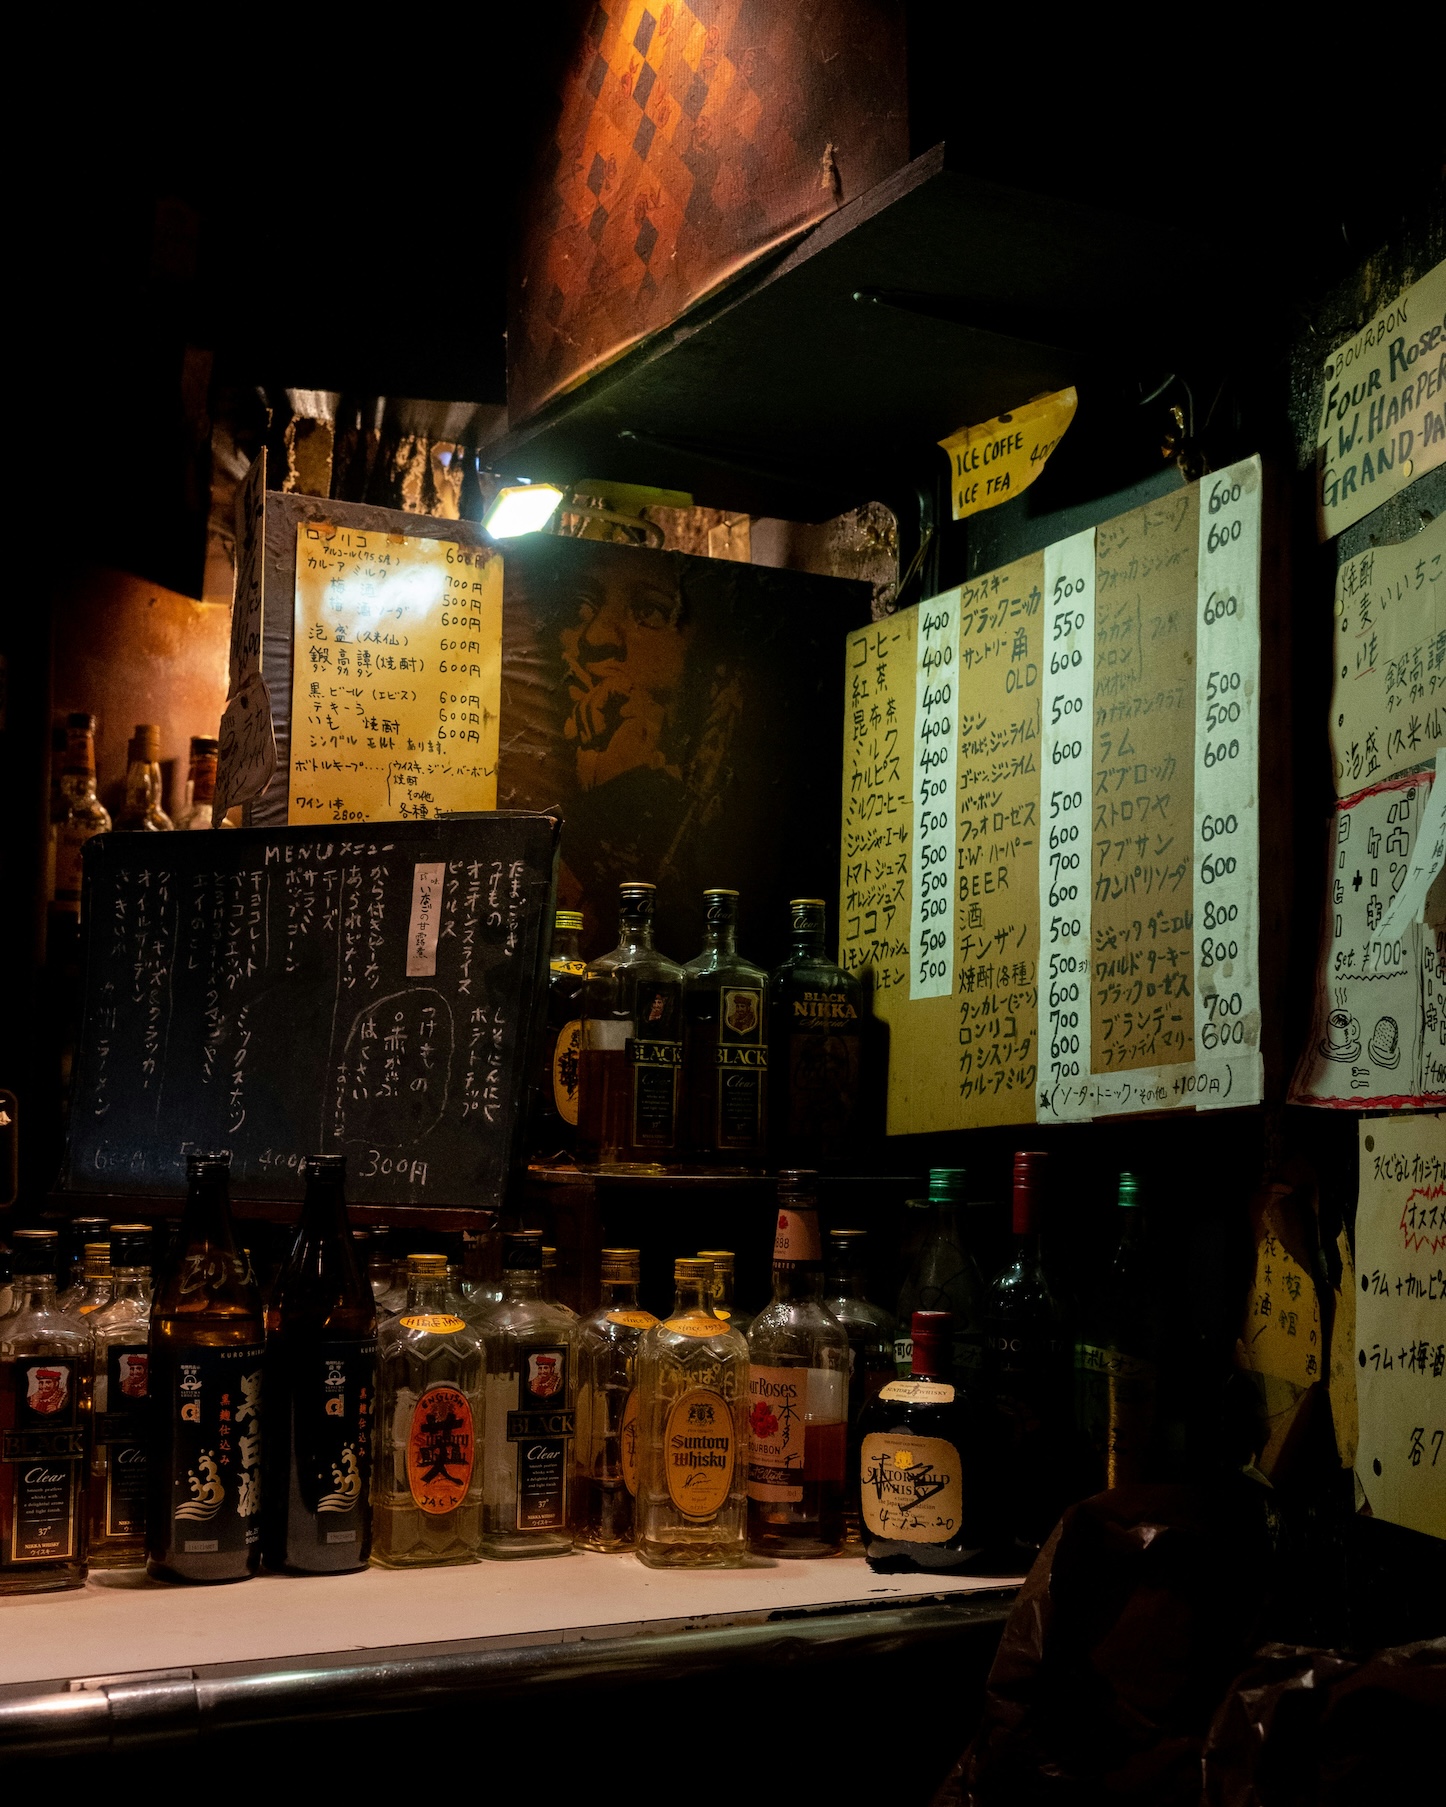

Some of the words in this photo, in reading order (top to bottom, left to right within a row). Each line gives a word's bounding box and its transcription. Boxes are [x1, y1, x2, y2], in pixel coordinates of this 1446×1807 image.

[1334, 298, 1408, 378] BOURBON
[1324, 368, 1382, 429] FOUR
[957, 447, 980, 476] ICE
[983, 432, 1024, 466] COFFE
[1322, 403, 1446, 508] GRAND-DA
[959, 483, 979, 508] ICE
[987, 472, 1010, 495] TEA
[1208, 480, 1241, 514] 600
[306, 529, 367, 548] ロンリコ
[1207, 520, 1241, 554] 600
[445, 575, 482, 595] 700円
[1342, 552, 1376, 599] 焼酎
[443, 594, 481, 614] 500円
[1053, 575, 1085, 606] 500
[1359, 593, 1374, 629] 麦
[1380, 554, 1442, 610] いいちこ
[963, 585, 1041, 636] ブラックニッカ
[1203, 591, 1237, 625] 600
[441, 613, 481, 633] 600円
[922, 612, 949, 640] 400
[1053, 610, 1085, 641] 550
[440, 639, 480, 654] 600円
[852, 632, 901, 668] コーヒー
[1356, 632, 1379, 670] いも
[440, 660, 481, 678] 600円
[922, 646, 952, 677] 400
[1050, 650, 1082, 675] 600
[852, 662, 888, 708] 紅茶
[1005, 663, 1038, 693] OLD
[1206, 671, 1241, 701] 500
[440, 691, 480, 708] 600円
[922, 684, 951, 715] 400
[1051, 694, 1083, 725] 500
[308, 714, 340, 731] いも
[362, 716, 400, 735] 焼酎
[438, 726, 480, 743] 600円
[439, 708, 480, 725] 600円
[853, 697, 898, 741] 昆布茶
[921, 717, 950, 744] 400
[963, 712, 987, 735] ジン
[1206, 702, 1240, 733] 500
[854, 729, 898, 766] ミルク
[1052, 740, 1082, 764] 600
[1100, 728, 1135, 763] ラム
[1204, 739, 1239, 768] 600
[1346, 727, 1381, 780] 泡盛
[852, 757, 900, 792] カルピス
[920, 747, 948, 774] 400
[1096, 753, 1176, 796] ズブロッカ
[393, 775, 418, 786] 焼酎
[920, 778, 947, 805] 500
[408, 789, 435, 803] その他
[961, 791, 1003, 814] バーボン
[1050, 790, 1082, 819] 500
[920, 811, 948, 839] 500
[1050, 825, 1079, 849] 600
[1202, 814, 1238, 842] 600
[265, 843, 333, 865] MENU
[339, 842, 394, 856] メニュー
[921, 845, 947, 870] 500
[1096, 834, 1174, 867] アブサン
[847, 854, 907, 887] トマトジュース
[1050, 853, 1080, 881] 700
[1095, 857, 1189, 902] カンパリソーダ
[1201, 853, 1236, 884] 600
[487, 860, 502, 926] つけもの
[921, 872, 948, 897] 500
[959, 866, 1008, 901] BEER
[1049, 881, 1077, 907] 600
[323, 870, 339, 931] チーズ
[441, 861, 463, 938] ピクルス
[921, 898, 947, 922] 500
[246, 871, 264, 977] チョコレート
[286, 867, 303, 971] ポップコーン
[793, 915, 820, 930] Clear
[847, 904, 896, 940] ココア
[960, 902, 983, 931] 酒
[1050, 915, 1081, 943] 500
[1203, 901, 1238, 930] 800
[225, 871, 247, 990] ベーコンエッグ
[920, 929, 946, 957] 500
[960, 924, 1027, 963] チンザノ
[842, 938, 909, 970] レモンスカッシュ
[1201, 937, 1238, 967] 800
[920, 960, 946, 983] 500
[804, 991, 848, 1001] BLACK
[1049, 981, 1079, 1008] 600
[1203, 993, 1242, 1020] 700
[792, 1000, 858, 1020] NIKKA
[1050, 1009, 1079, 1036] 700
[1101, 1003, 1184, 1041] ブランデー
[959, 1016, 1017, 1044] ロンリコ
[1202, 1021, 1244, 1050] 600
[352, 1017, 378, 1099] はくさい
[410, 1007, 437, 1092] つけもの
[716, 1047, 767, 1066] BLACK
[959, 1030, 1037, 1073] カシスソーダ
[1050, 1035, 1080, 1058] 600
[726, 1074, 757, 1088] Clear
[959, 1065, 1037, 1099] カルーアミルク
[1050, 1061, 1080, 1084] 700
[359, 1150, 428, 1185] 300円
[221, 1351, 244, 1359] KURO
[420, 1390, 466, 1410] ENGLISH
[759, 1376, 798, 1399] Roses
[919, 1387, 950, 1397] WHISKY
[511, 1416, 575, 1435] BLACK
[527, 1445, 560, 1460] Clear
[671, 1434, 730, 1453] Suntory
[24, 1466, 66, 1484] Clear
[672, 1451, 727, 1470] Whisky
[925, 1474, 951, 1486] OLD
[421, 1493, 459, 1508] JACK
